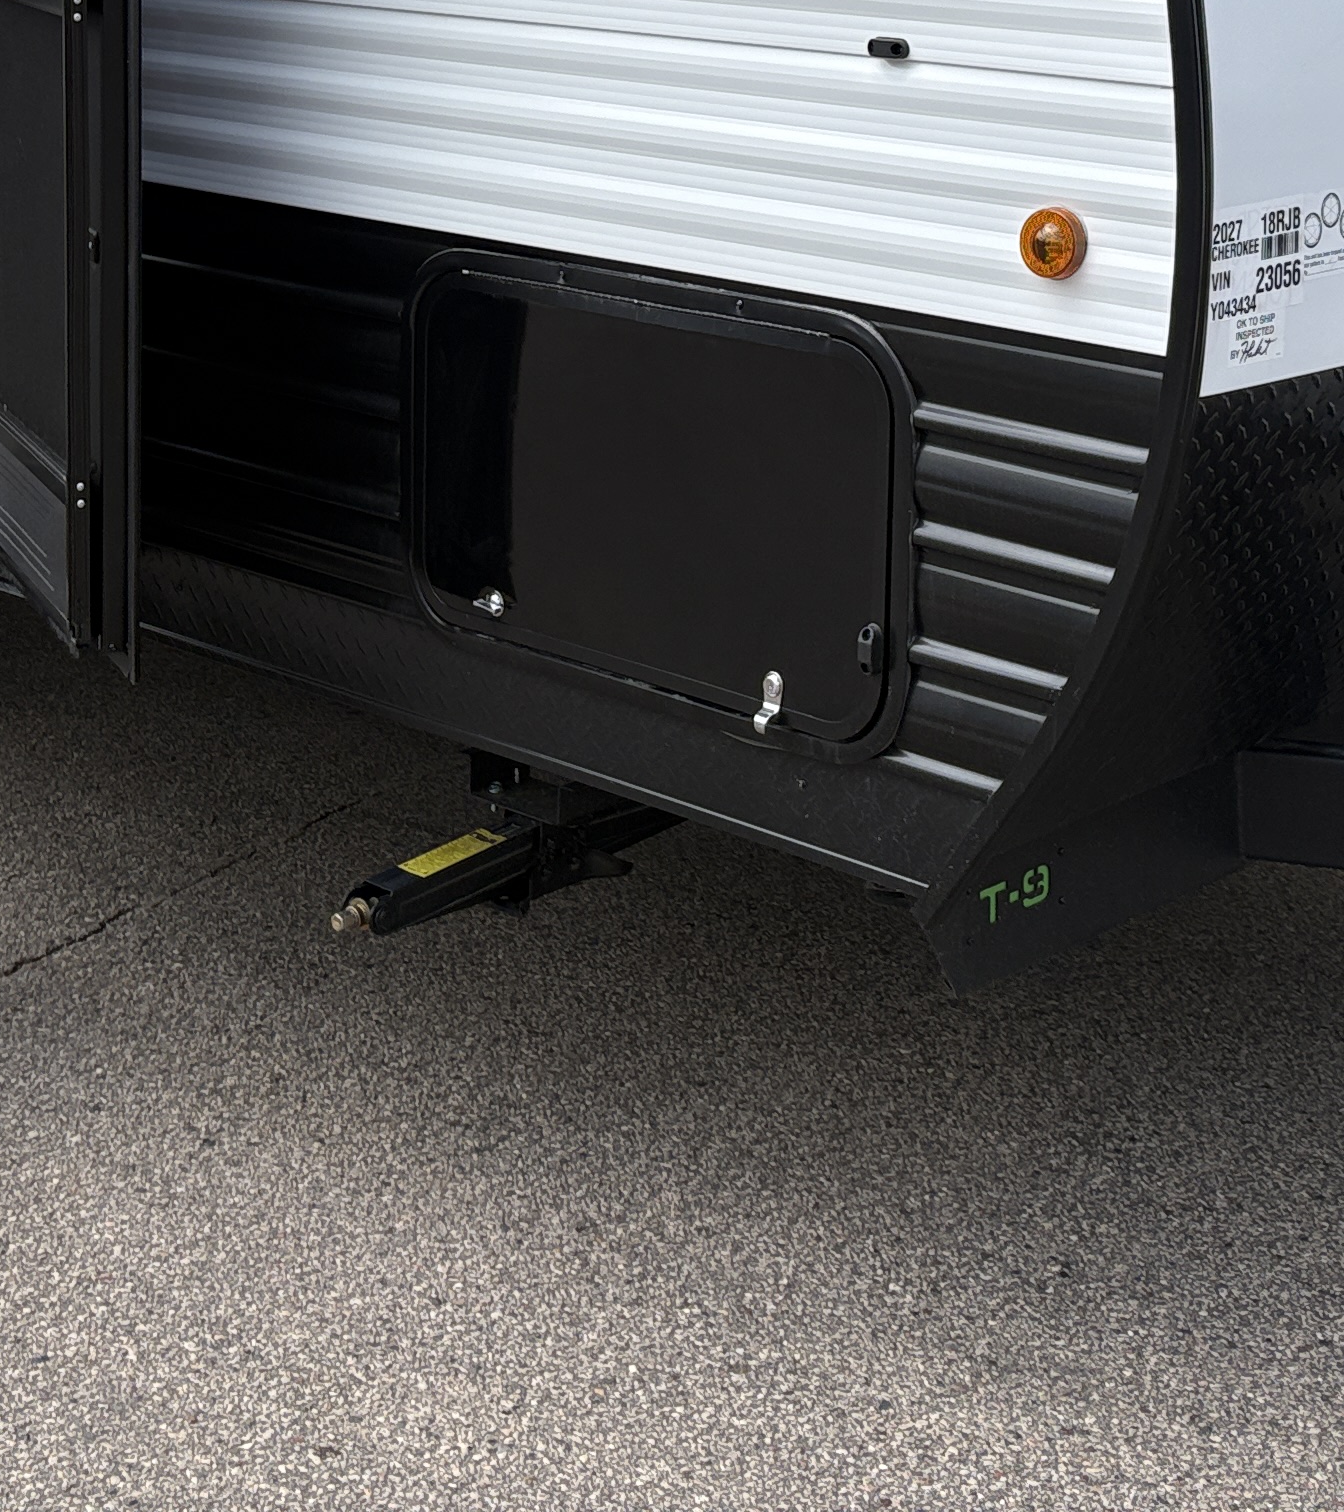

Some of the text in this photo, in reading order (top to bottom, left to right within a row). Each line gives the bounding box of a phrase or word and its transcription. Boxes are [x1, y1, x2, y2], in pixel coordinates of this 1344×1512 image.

[1213, 206, 1301, 245] 2027 18RJB
[1211, 237, 1260, 261] CHEROKEE
[1211, 270, 1231, 292] VIN
[1256, 259, 1301, 293] 23056
[1210, 294, 1257, 321] Y043434
[1249, 316, 1259, 326] TO
[1260, 312, 1276, 325] SHIP
[1235, 325, 1275, 341] INSPECTED
[980, 865, 1050, 924] T-9
